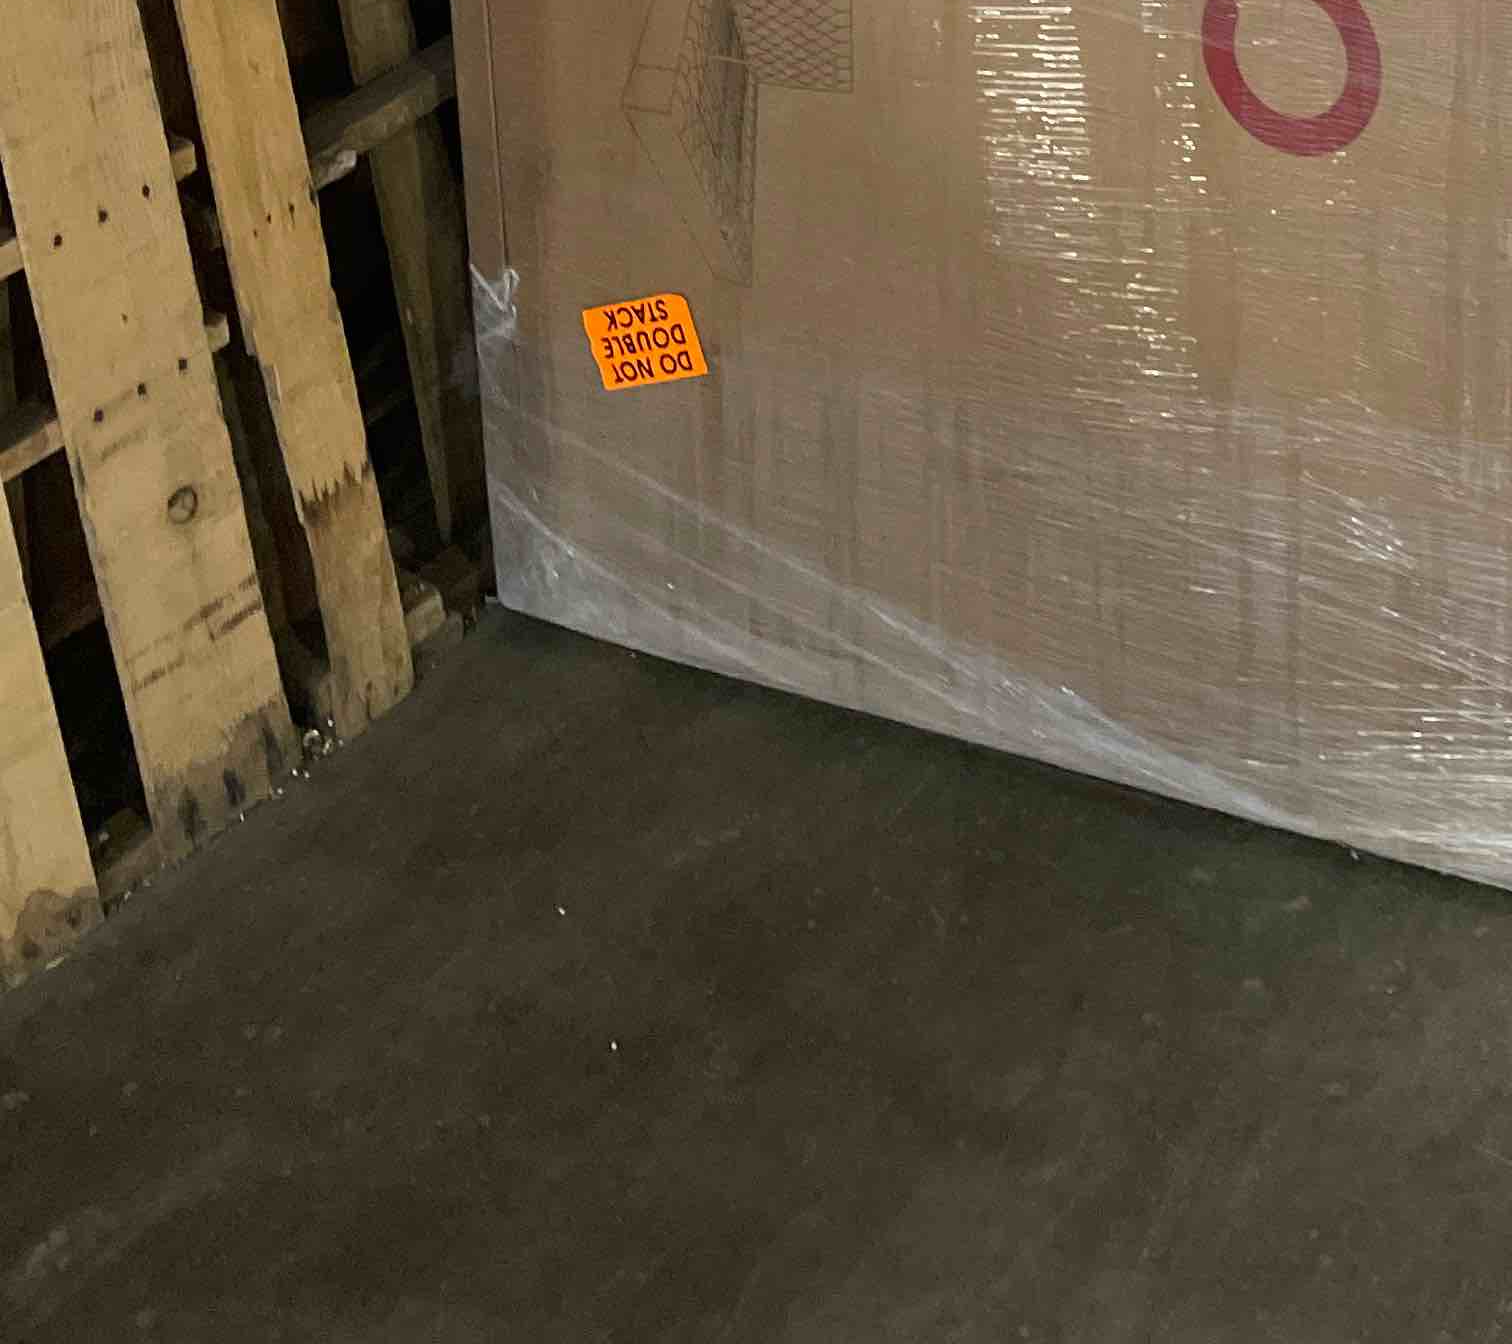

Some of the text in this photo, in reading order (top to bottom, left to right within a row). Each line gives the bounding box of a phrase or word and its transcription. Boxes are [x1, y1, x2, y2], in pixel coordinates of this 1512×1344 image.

[603, 300, 669, 331] STACK
[600, 324, 687, 359] DOUBLE
[611, 350, 693, 384] DO NOT
